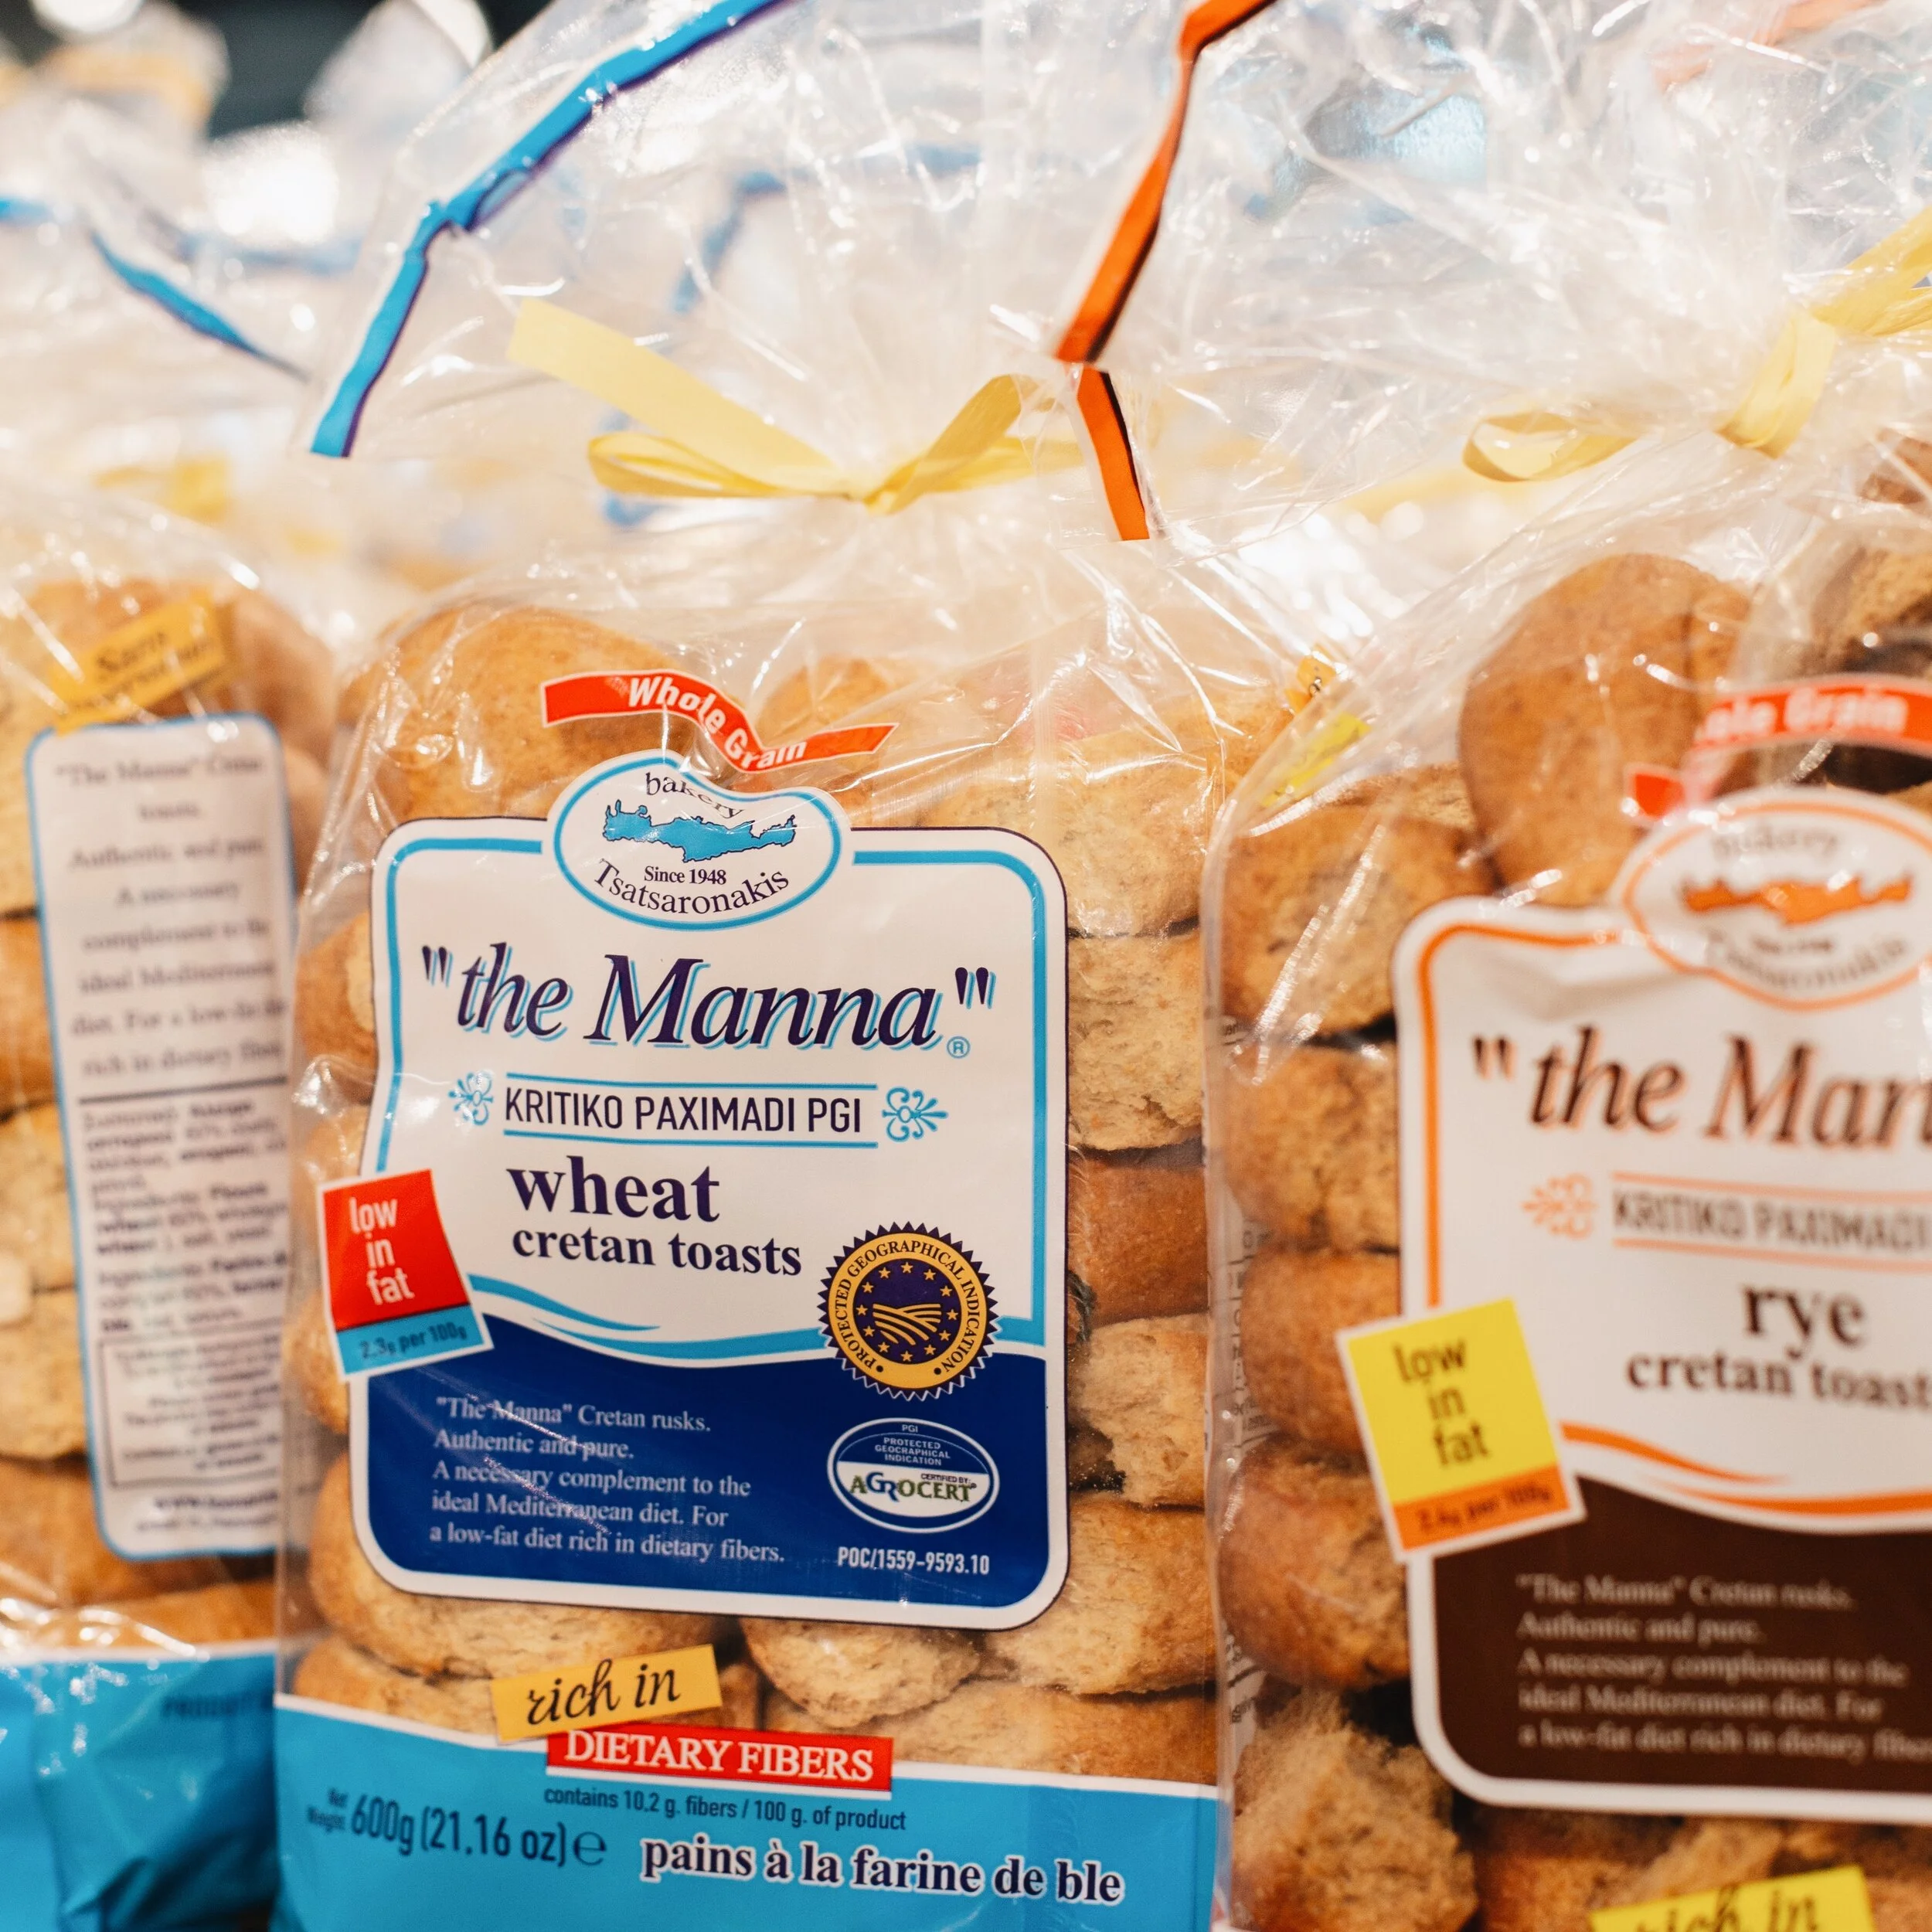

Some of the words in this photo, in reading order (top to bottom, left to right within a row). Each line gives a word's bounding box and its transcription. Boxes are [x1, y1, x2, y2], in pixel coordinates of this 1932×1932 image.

[628, 676, 726, 733] Whole
[723, 730, 808, 770] Grain
[645, 773, 744, 819] bakery
[594, 858, 790, 915] Tsatsaronakis
[644, 866, 685, 884] Since
[688, 869, 727, 886] 1948
[505, 1086, 623, 1131] KRITIKO
[635, 1096, 795, 1132] PAXIMADI
[808, 1097, 862, 1133] PGI
[1698, 1031, 1932, 1151] Man
[507, 1155, 721, 1223] wheat
[349, 1196, 398, 1234] low
[1612, 1189, 1747, 1240] KRITIKO
[364, 1231, 396, 1269] in
[512, 1224, 656, 1267] cretan
[668, 1236, 803, 1276] toasts
[847, 1240, 962, 1280] GEOGRAPHICAL
[366, 1267, 415, 1305] fat
[834, 1278, 876, 1369] PROTECTED
[941, 1279, 981, 1372] INDICATION
[1740, 1284, 1866, 1359] rye
[1393, 1337, 1468, 1385] low
[1624, 1352, 1794, 1398] cretan
[436, 1396, 485, 1419] "The
[492, 1401, 572, 1423] Manna"
[577, 1404, 645, 1427] Cretan
[651, 1410, 710, 1432] rusks.
[1427, 1381, 1468, 1420] in
[434, 1429, 534, 1453] Authentic
[539, 1435, 577, 1456] and
[581, 1440, 634, 1461] pure.
[883, 1437, 941, 1450] PROTECTED
[902, 1424, 918, 1433] PGI
[1431, 1420, 1492, 1468] fat
[874, 1444, 951, 1459] GEOGRAPHICAL
[884, 1454, 942, 1466] INDICATION
[433, 1460, 450, 1480] A
[454, 1464, 553, 1489] necessary
[558, 1470, 686, 1494] complement
[692, 1475, 713, 1495] to
[719, 1475, 751, 1497] the
[920, 1473, 957, 1483] CERTIFIED
[431, 1489, 478, 1512] ideal
[485, 1492, 633, 1522] Mediterranean
[638, 1502, 684, 1526] diet.
[692, 1505, 729, 1527] For
[429, 1526, 442, 1543] a
[447, 1522, 519, 1547] low-fat
[523, 1526, 563, 1549] diet
[568, 1529, 609, 1553] rich
[615, 1533, 634, 1553] in
[640, 1536, 713, 1564] dietary
[719, 1537, 785, 1563] fibers.
[837, 1546, 990, 1576] POC/1559-9593.10
[1643, 1611, 1696, 1644] and
[1517, 1648, 1543, 1678] A
[526, 1658, 621, 1725] rich
[634, 1662, 681, 1708] in
[564, 1730, 732, 1772] DIETARY
[737, 1744, 874, 1783] FIBERS
[351, 1794, 414, 1856] 600g
[420, 1804, 512, 1857] (21.16
[543, 1786, 618, 1808] contains
[623, 1791, 661, 1815] 10.2
[663, 1797, 682, 1818] g.
[685, 1794, 738, 1818] fibers
[740, 1798, 748, 1821] /
[753, 1800, 786, 1823] 100
[790, 1805, 808, 1826] g.
[811, 1804, 832, 1825] of
[835, 1808, 906, 1832] product
[640, 1834, 757, 1883] pains
[762, 1839, 791, 1883] à
[799, 1841, 842, 1886] la
[851, 1847, 985, 1896] farine
[993, 1855, 1045, 1897] de
[1055, 1859, 1125, 1906] ble
